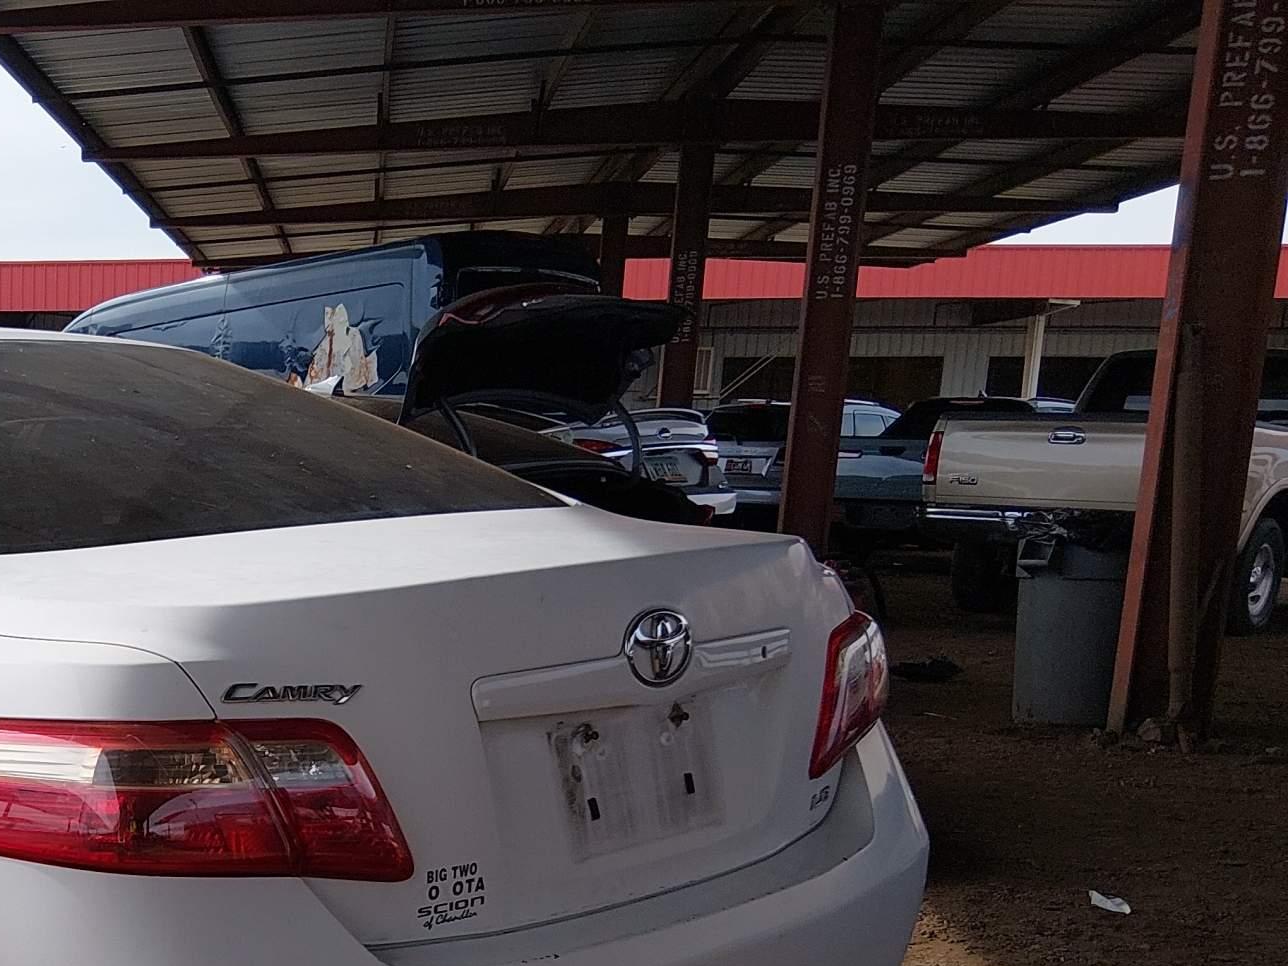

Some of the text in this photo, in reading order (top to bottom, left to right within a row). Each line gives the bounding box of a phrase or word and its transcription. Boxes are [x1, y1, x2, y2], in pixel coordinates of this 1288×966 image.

[1209, 125, 1242, 181] U.S.
[826, 163, 842, 193] INC.
[819, 201, 838, 262] PREFAB
[830, 164, 857, 299] 1-866-799-0969
[221, 682, 363, 705] CAMRY
[426, 862, 478, 884] BIG TWO
[423, 916, 434, 931] of
